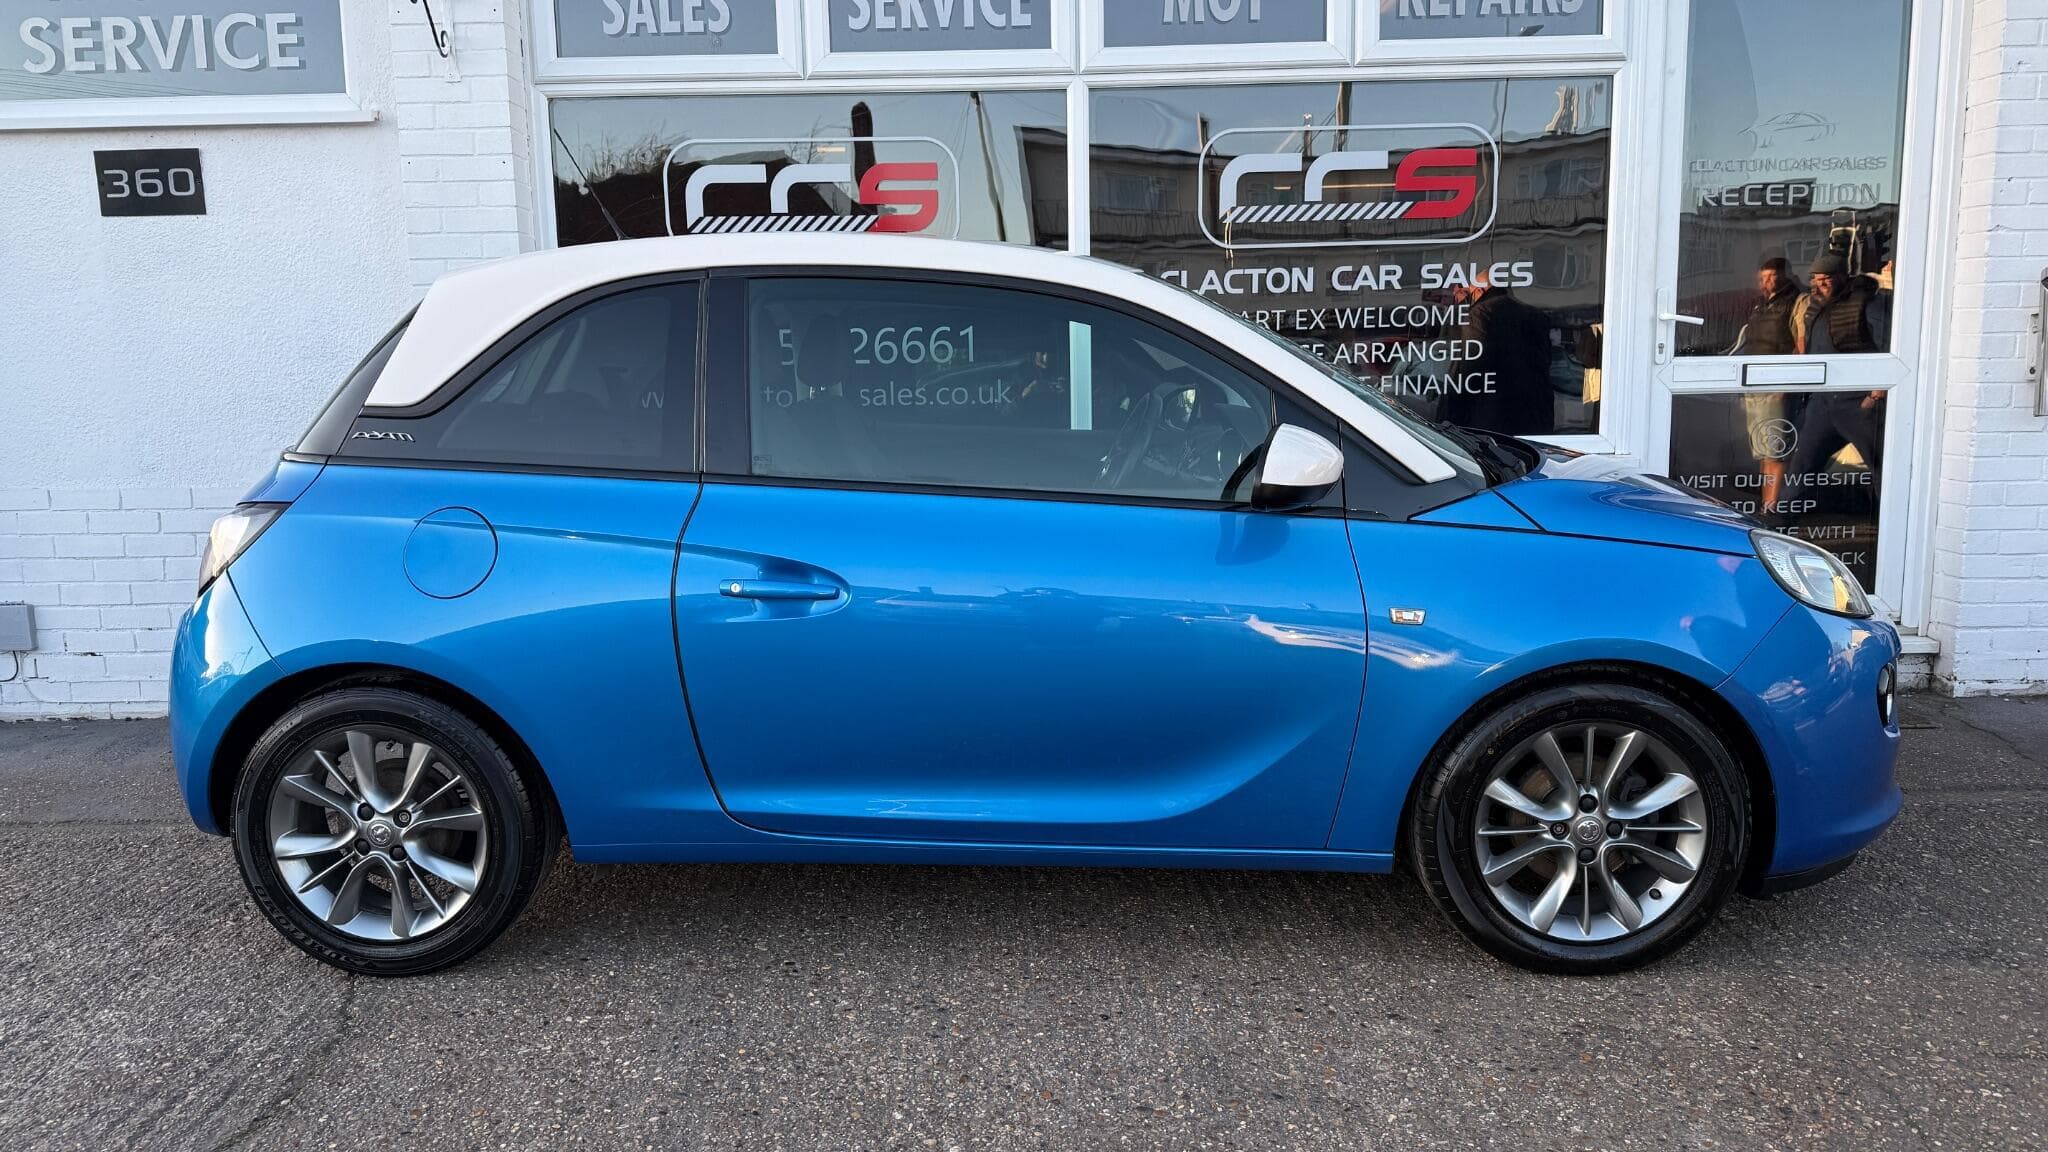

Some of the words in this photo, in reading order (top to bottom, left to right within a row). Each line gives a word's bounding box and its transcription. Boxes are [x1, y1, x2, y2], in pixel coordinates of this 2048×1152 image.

[19, 12, 303, 74] SERVICE
[103, 167, 196, 199] 360
[1697, 182, 1881, 207] RECEPTION
[1331, 264, 1403, 292] CAR
[1420, 261, 1534, 290] SALES
[1295, 308, 1326, 331] EX
[1335, 304, 1471, 330] WELCOME
[1333, 339, 1483, 365] ARRANGED
[1380, 371, 1497, 397] FINANCE
[1679, 473, 1728, 490] VISIT
[1734, 473, 1777, 488] OUR
[1784, 471, 1873, 487] WEBSITE
[1763, 500, 1817, 514] KEEP
[1807, 525, 1856, 540] WITH
